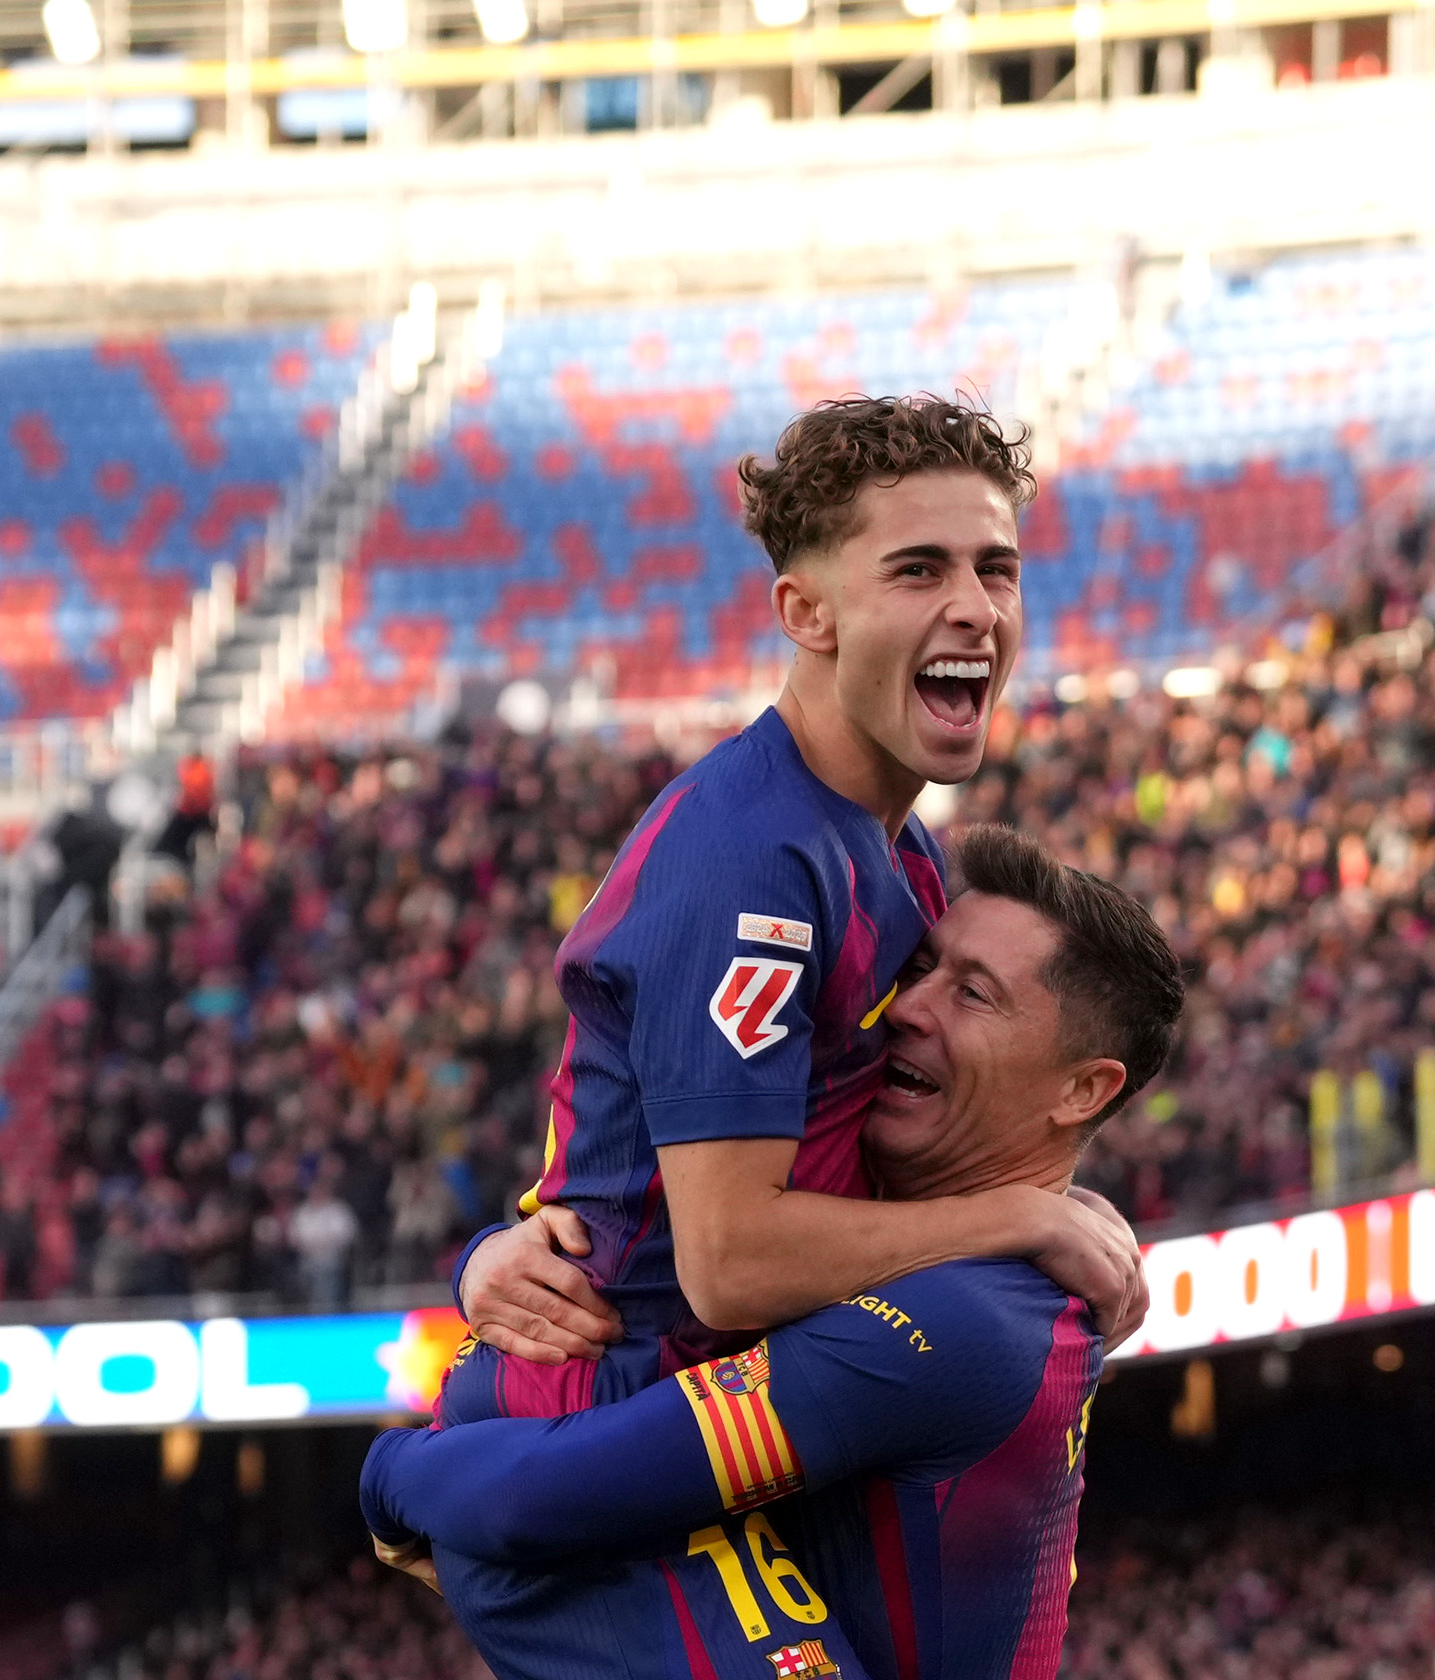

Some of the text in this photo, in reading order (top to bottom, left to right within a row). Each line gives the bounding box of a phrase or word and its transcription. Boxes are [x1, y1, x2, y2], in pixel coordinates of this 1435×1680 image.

[841, 1295, 934, 1353] IGHT tv
[686, 1511, 828, 1643] 16
